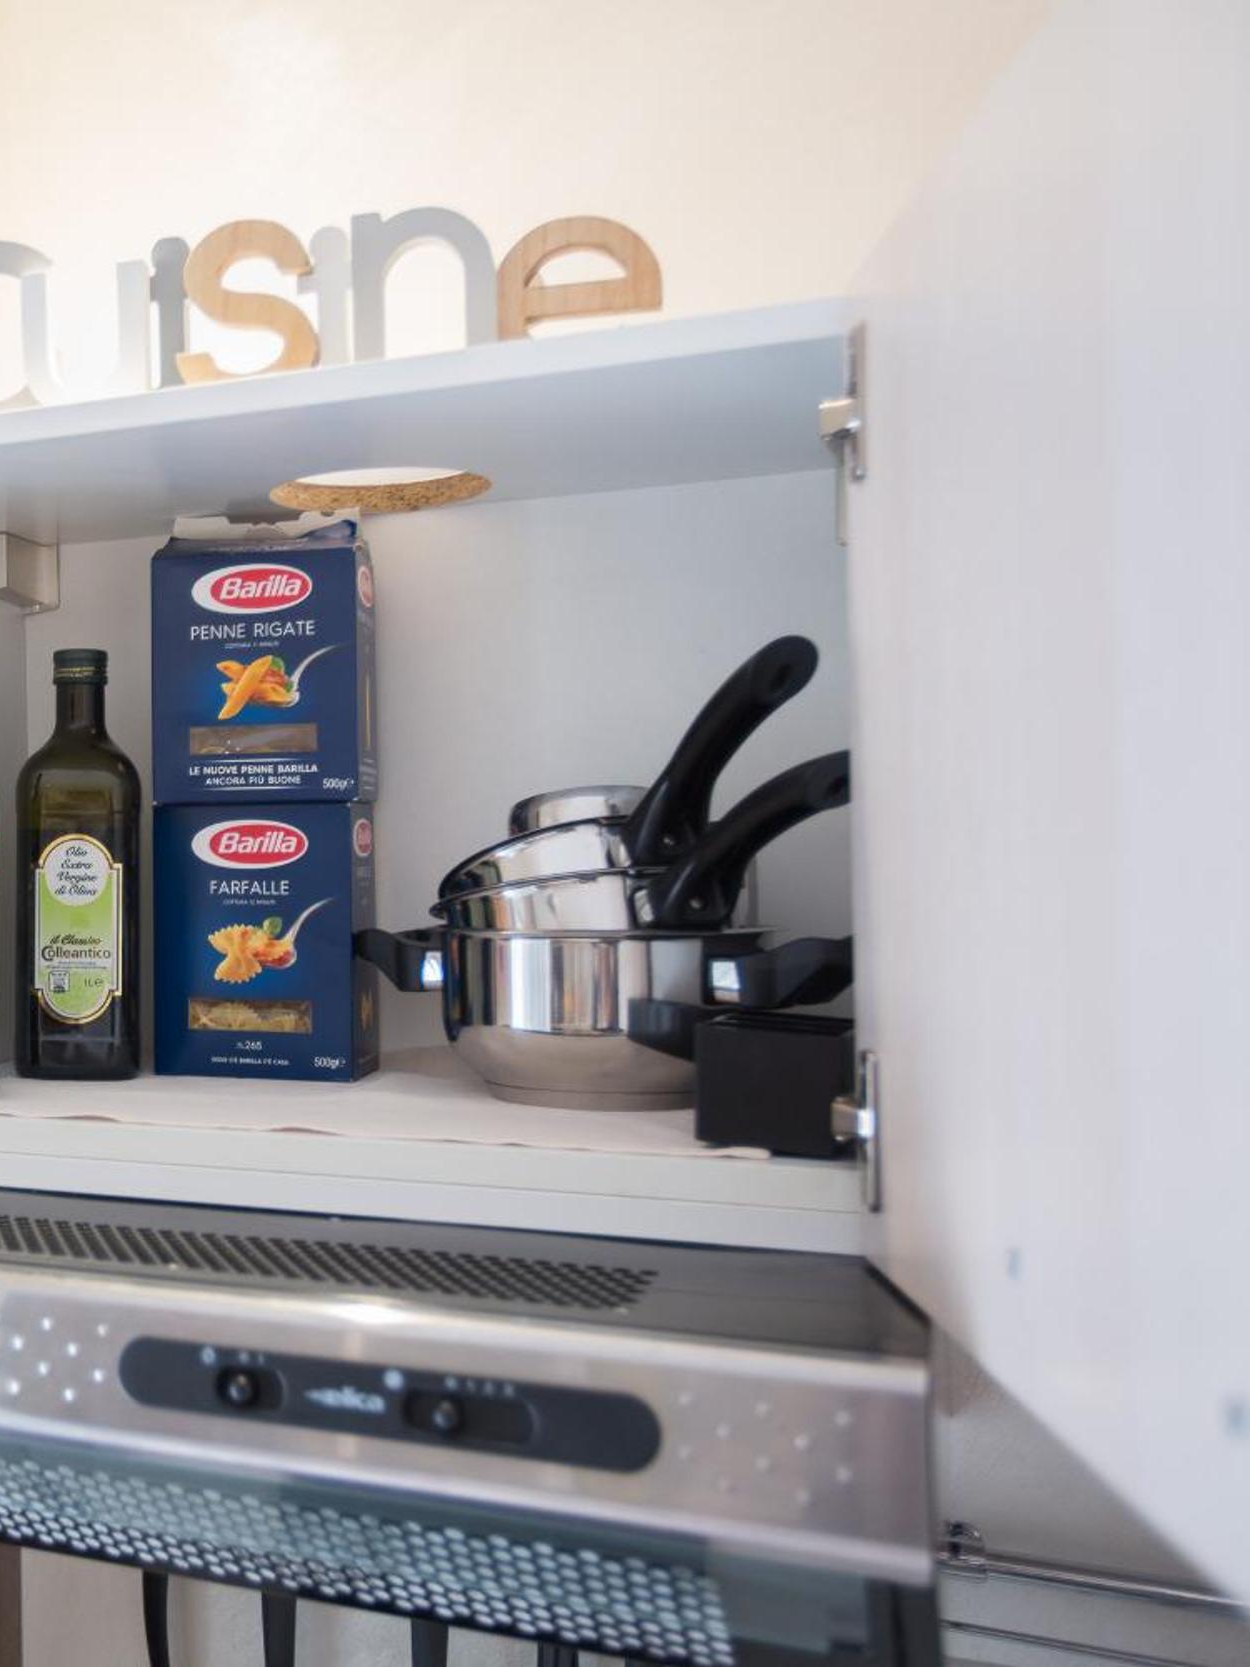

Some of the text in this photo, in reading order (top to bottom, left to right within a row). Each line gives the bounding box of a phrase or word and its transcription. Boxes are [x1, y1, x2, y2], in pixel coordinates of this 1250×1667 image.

[220, 574, 303, 600] Barilla
[190, 620, 316, 640] PENNE RIGATE
[189, 764, 318, 776] LE NUOVE PENNE BARILLA
[205, 776, 246, 786] ANCORA
[268, 775, 302, 785] BUONE
[218, 831, 298, 854] Barilla
[66, 846, 88, 857] Olio
[61, 859, 93, 870] Extra
[57, 871, 97, 883] Vergine
[69, 884, 98, 896] Oliva
[210, 880, 290, 895] FARFALLE
[41, 945, 111, 961] Colleantico
